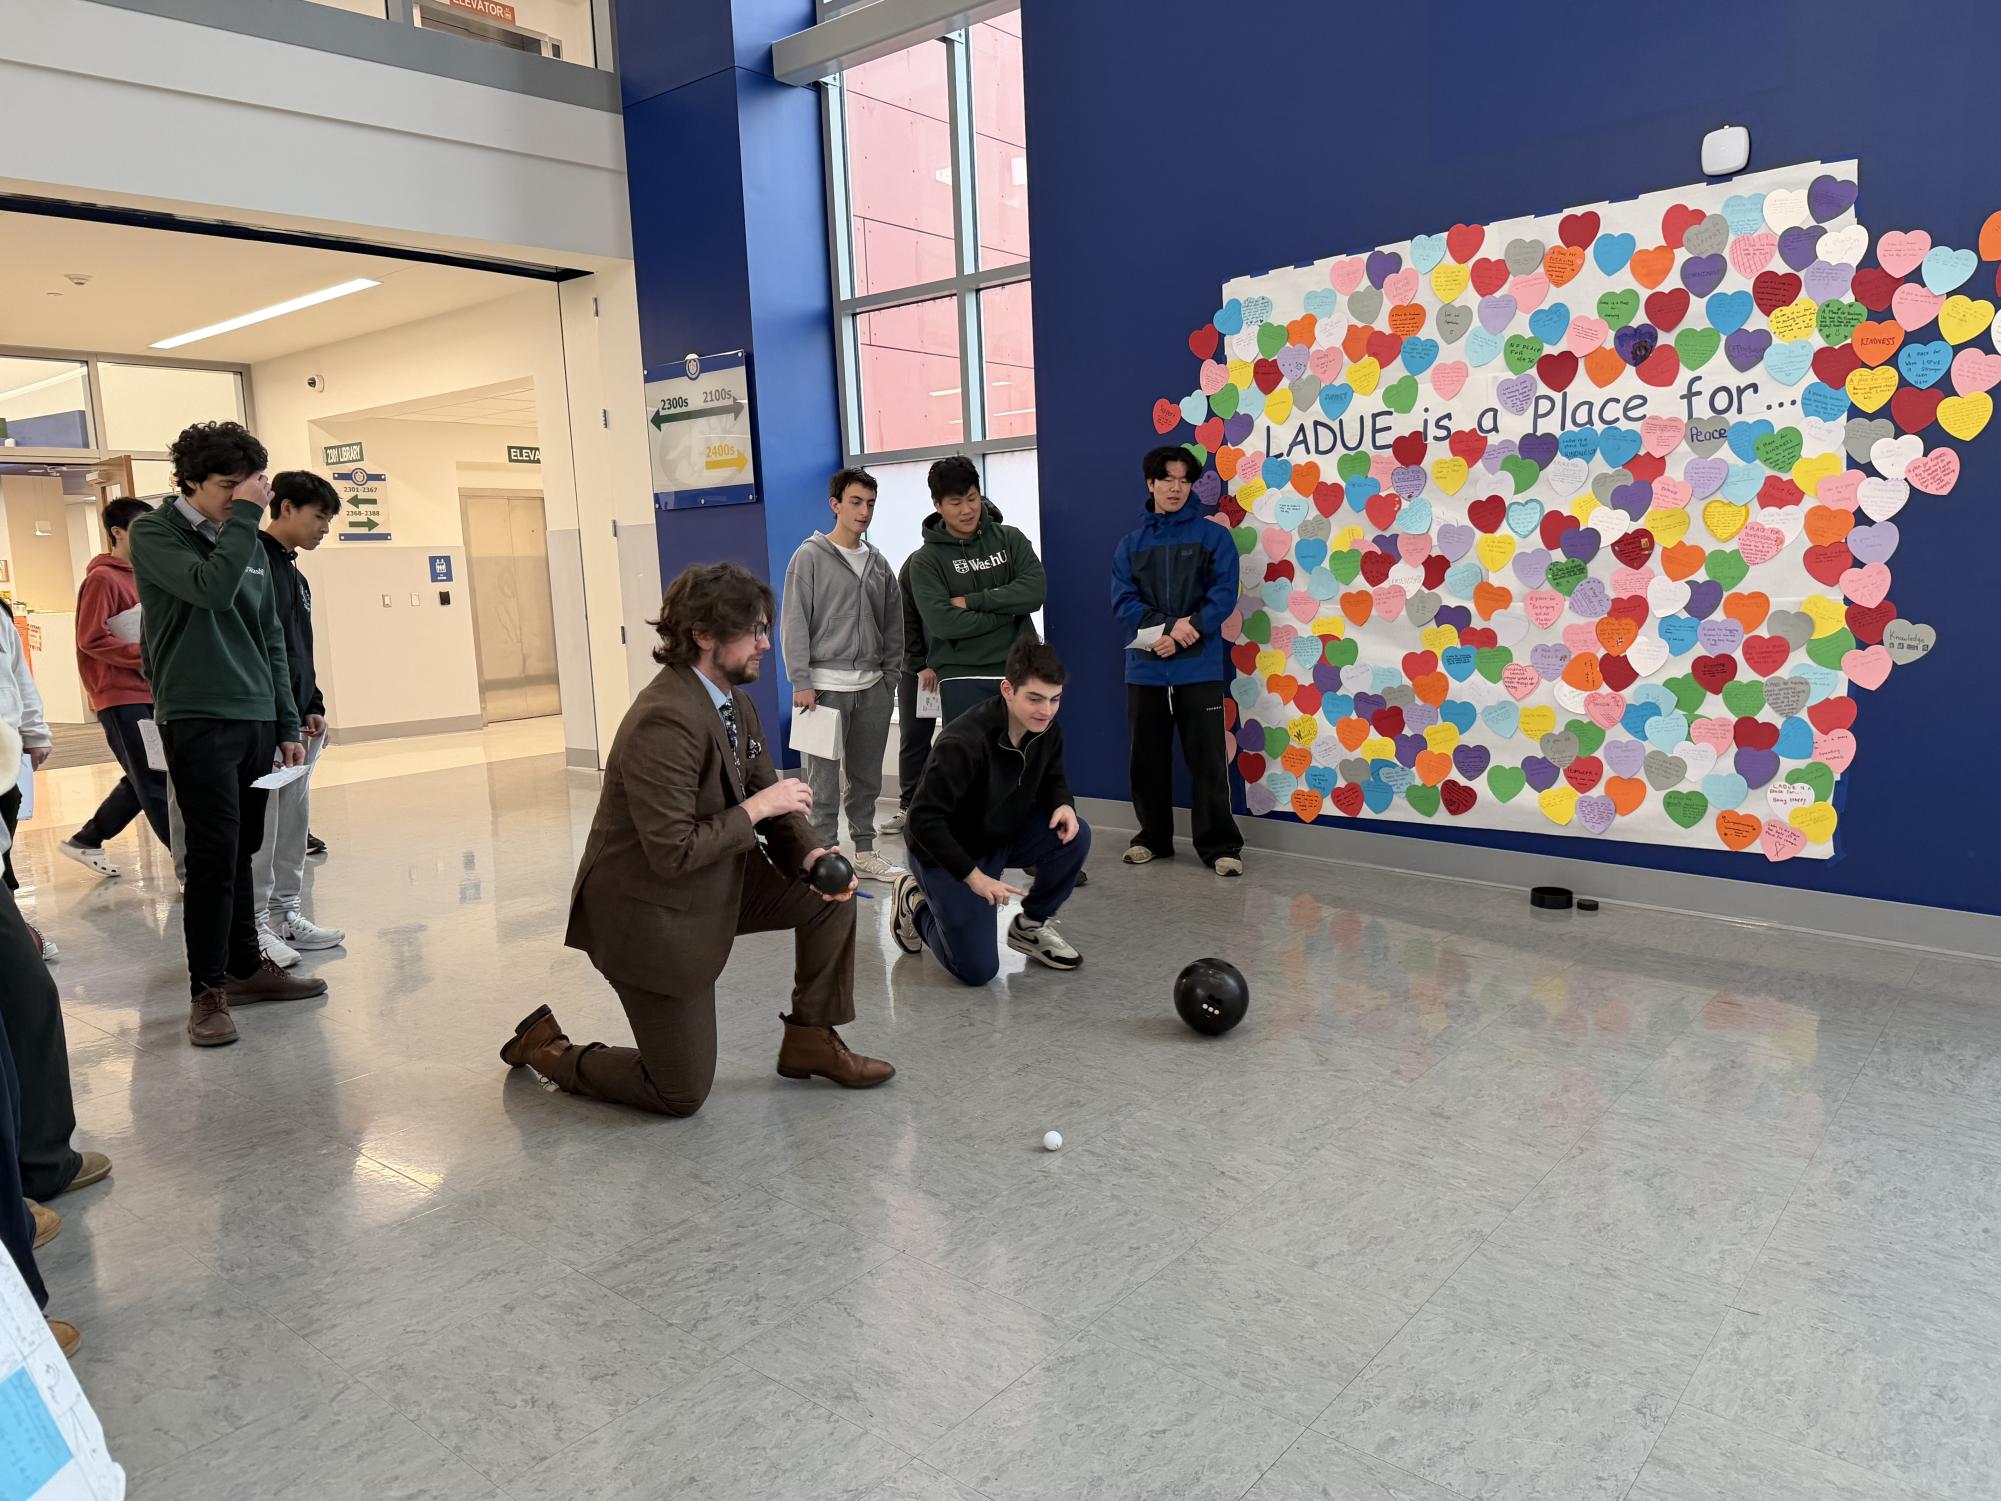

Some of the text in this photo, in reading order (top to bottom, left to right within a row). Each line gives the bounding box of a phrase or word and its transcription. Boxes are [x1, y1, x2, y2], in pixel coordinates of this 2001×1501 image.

[1860, 336, 1895, 347] KINDNESS
[660, 388, 732, 411] 2300s 2100s
[1266, 410, 1394, 458] LADUE
[1422, 407, 1452, 443] is
[1477, 407, 1500, 435] a
[1532, 391, 1649, 434] Place
[1690, 426, 1728, 443] Peace
[339, 444, 362, 462] LIBRARY
[706, 443, 735, 458] 2400s
[968, 550, 1008, 571] WashU
[1889, 629, 1926, 644] Knowledge
